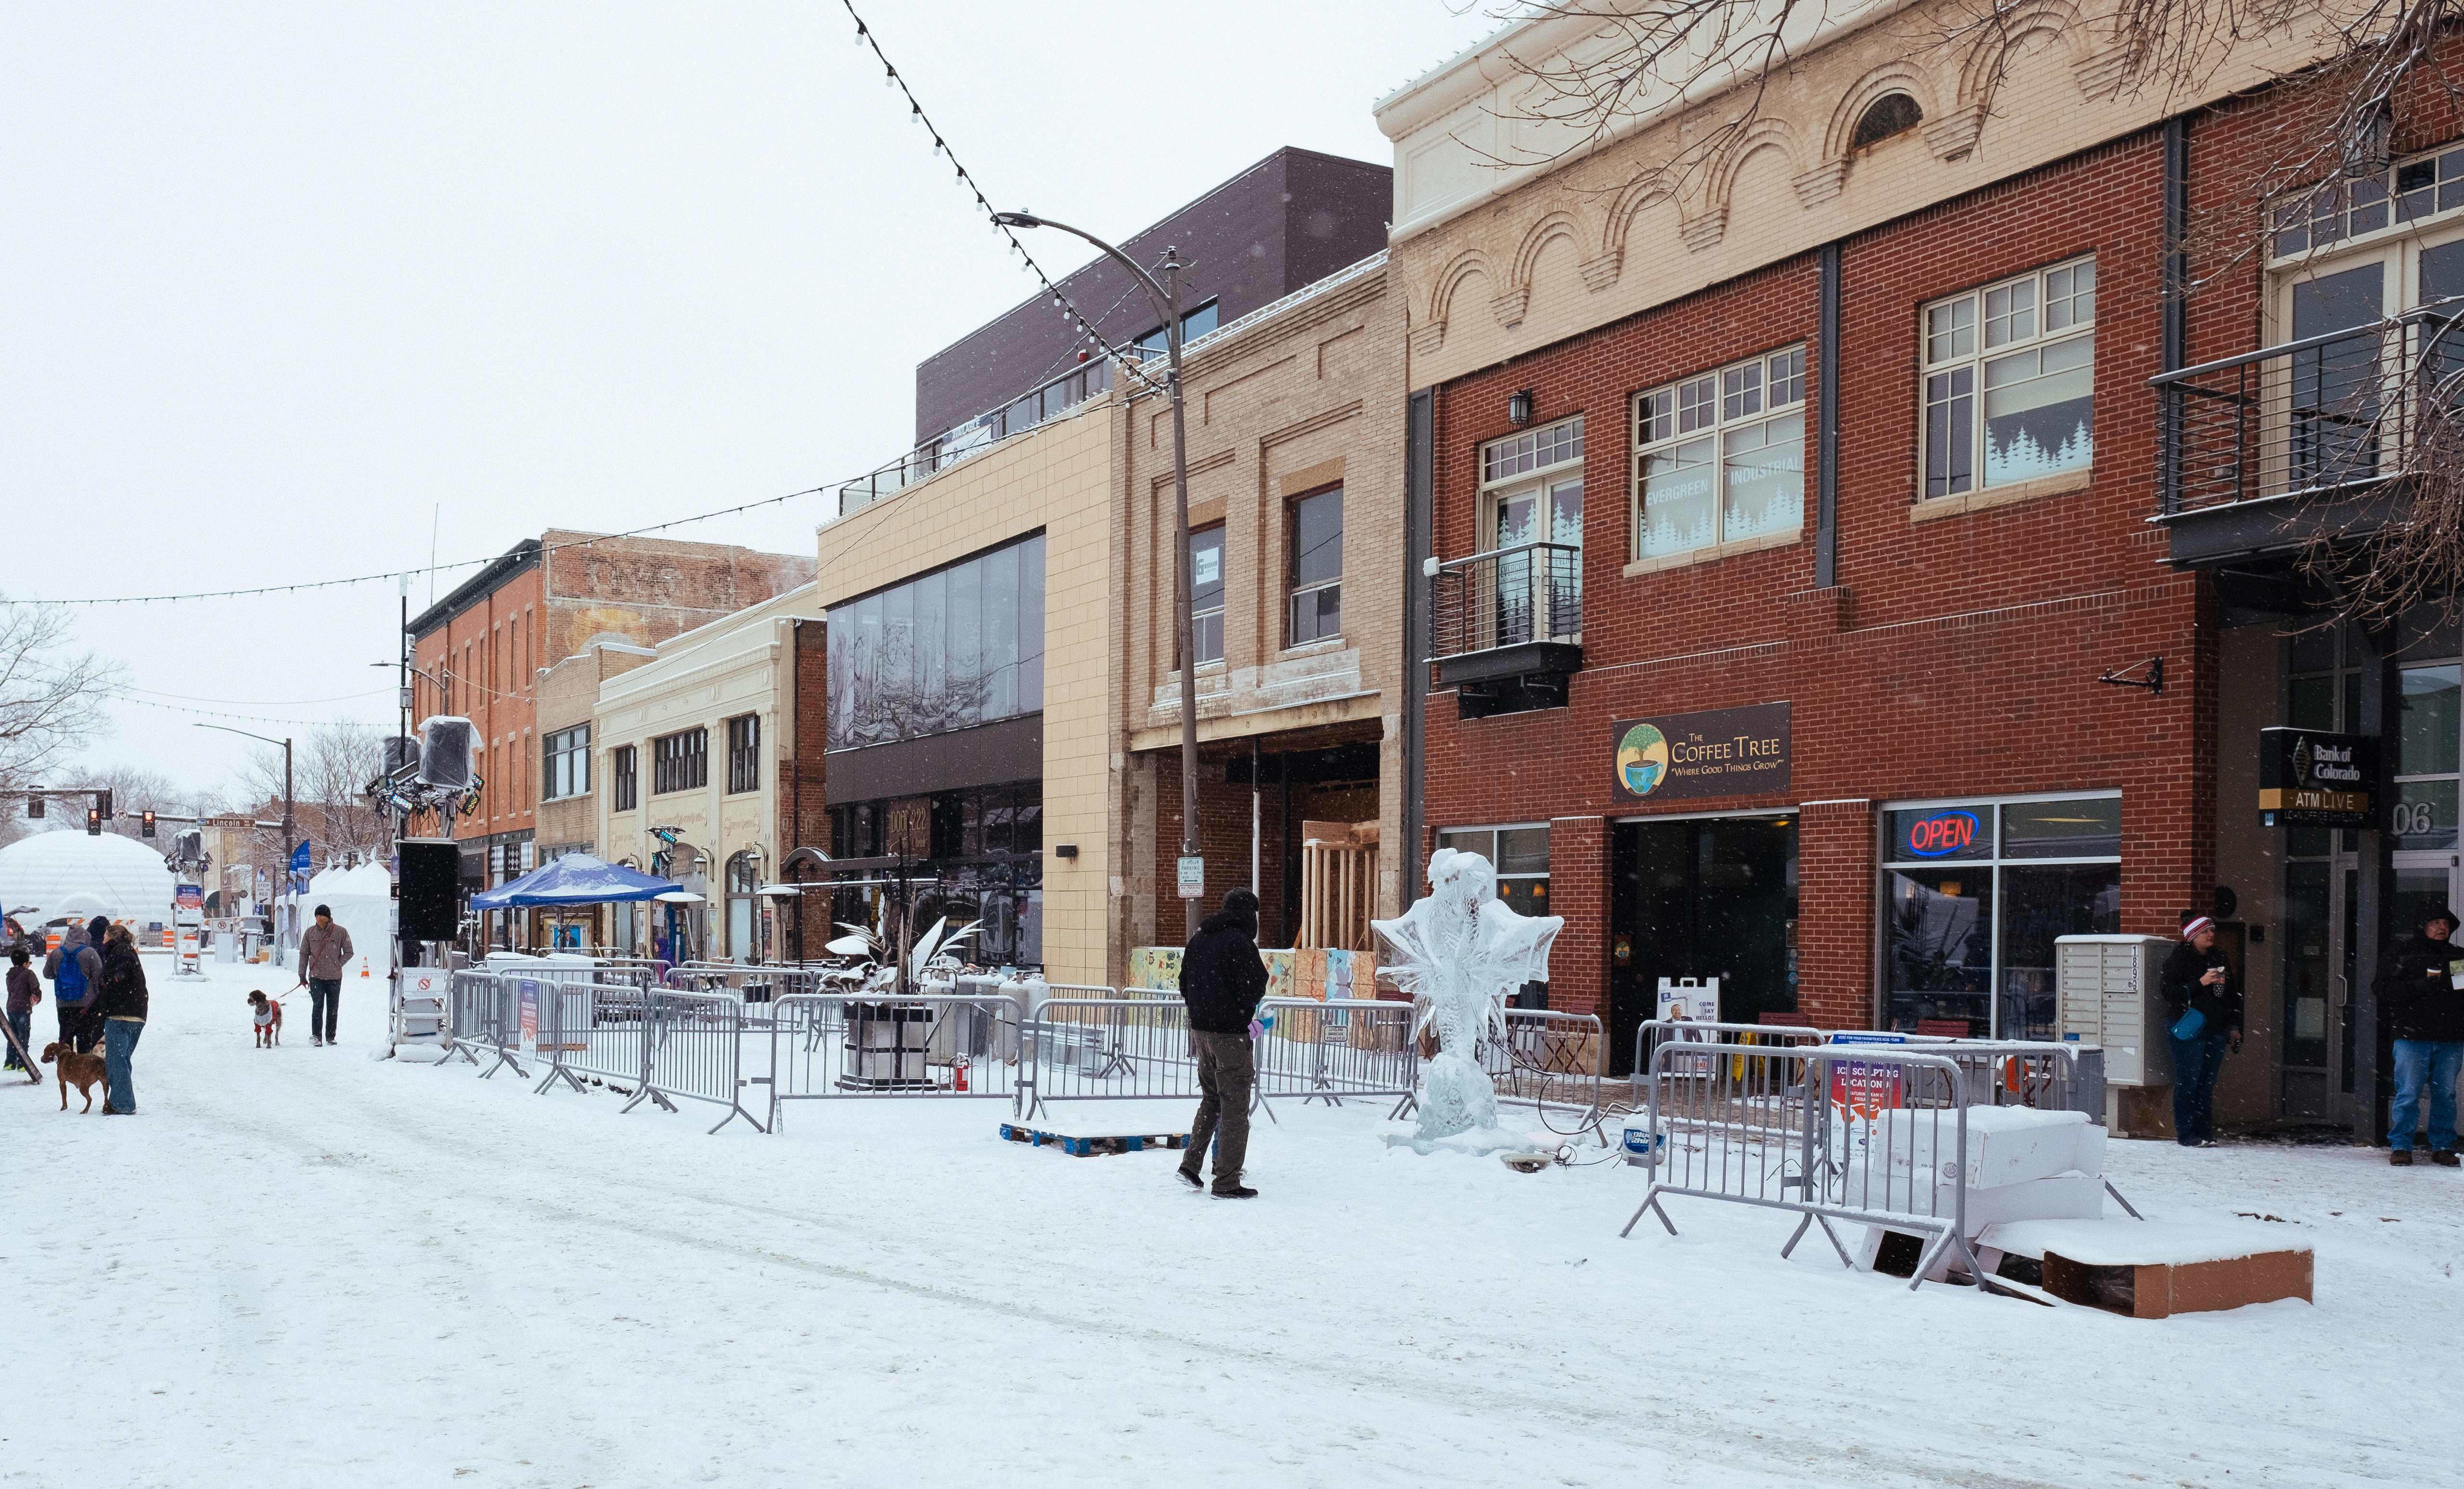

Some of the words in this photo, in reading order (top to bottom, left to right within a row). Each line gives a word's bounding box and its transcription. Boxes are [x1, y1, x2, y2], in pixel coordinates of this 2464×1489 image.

[952, 418, 980, 441] AVAILABLE
[1646, 480, 1708, 506] EVERGREEN
[1731, 456, 1802, 485] INDUSTRIAL
[1672, 743, 1731, 763] COFFEE
[1733, 736, 1780, 757] TREE
[2314, 744, 2339, 761] Bank
[2340, 747, 2352, 762] of
[1701, 765, 1722, 774] GOOD
[1724, 763, 1751, 772] THINGS
[2314, 763, 2360, 781] Colorado
[2296, 792, 2320, 807] ATM
[2323, 794, 2353, 809] LIVE
[912, 807, 926, 831] 222
[1911, 818, 1972, 849] OPEN
[1841, 1078, 1883, 1088] LCATON
